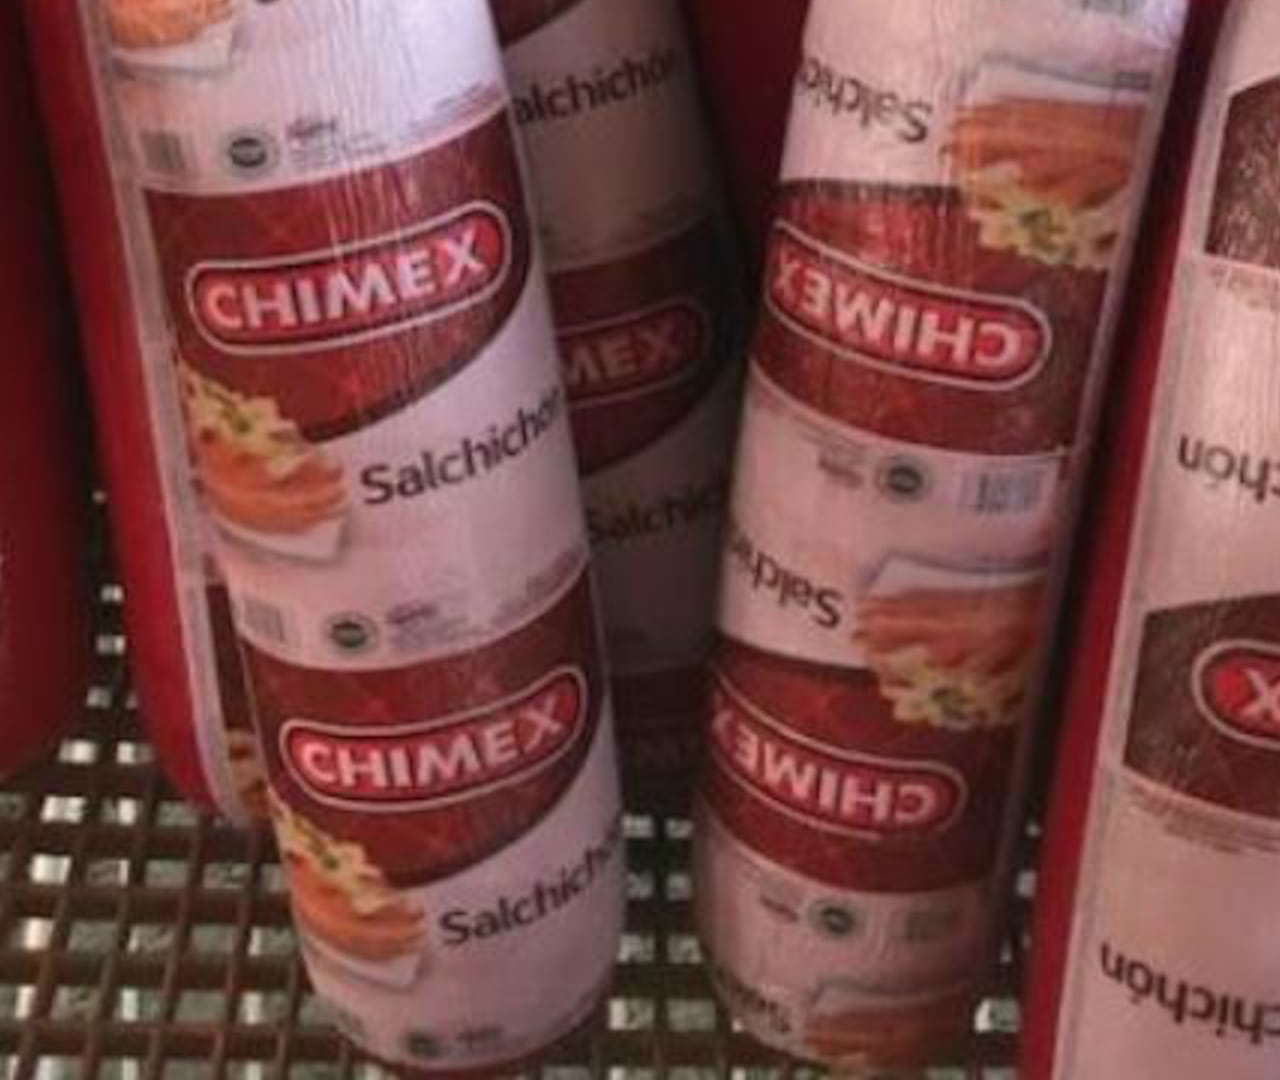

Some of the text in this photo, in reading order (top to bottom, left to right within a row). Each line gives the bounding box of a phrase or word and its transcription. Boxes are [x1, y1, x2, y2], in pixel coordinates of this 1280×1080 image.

[204, 228, 487, 329] CHIMEX
[773, 249, 1022, 368] CHIMEX
[300, 693, 564, 789] CHIMEX
